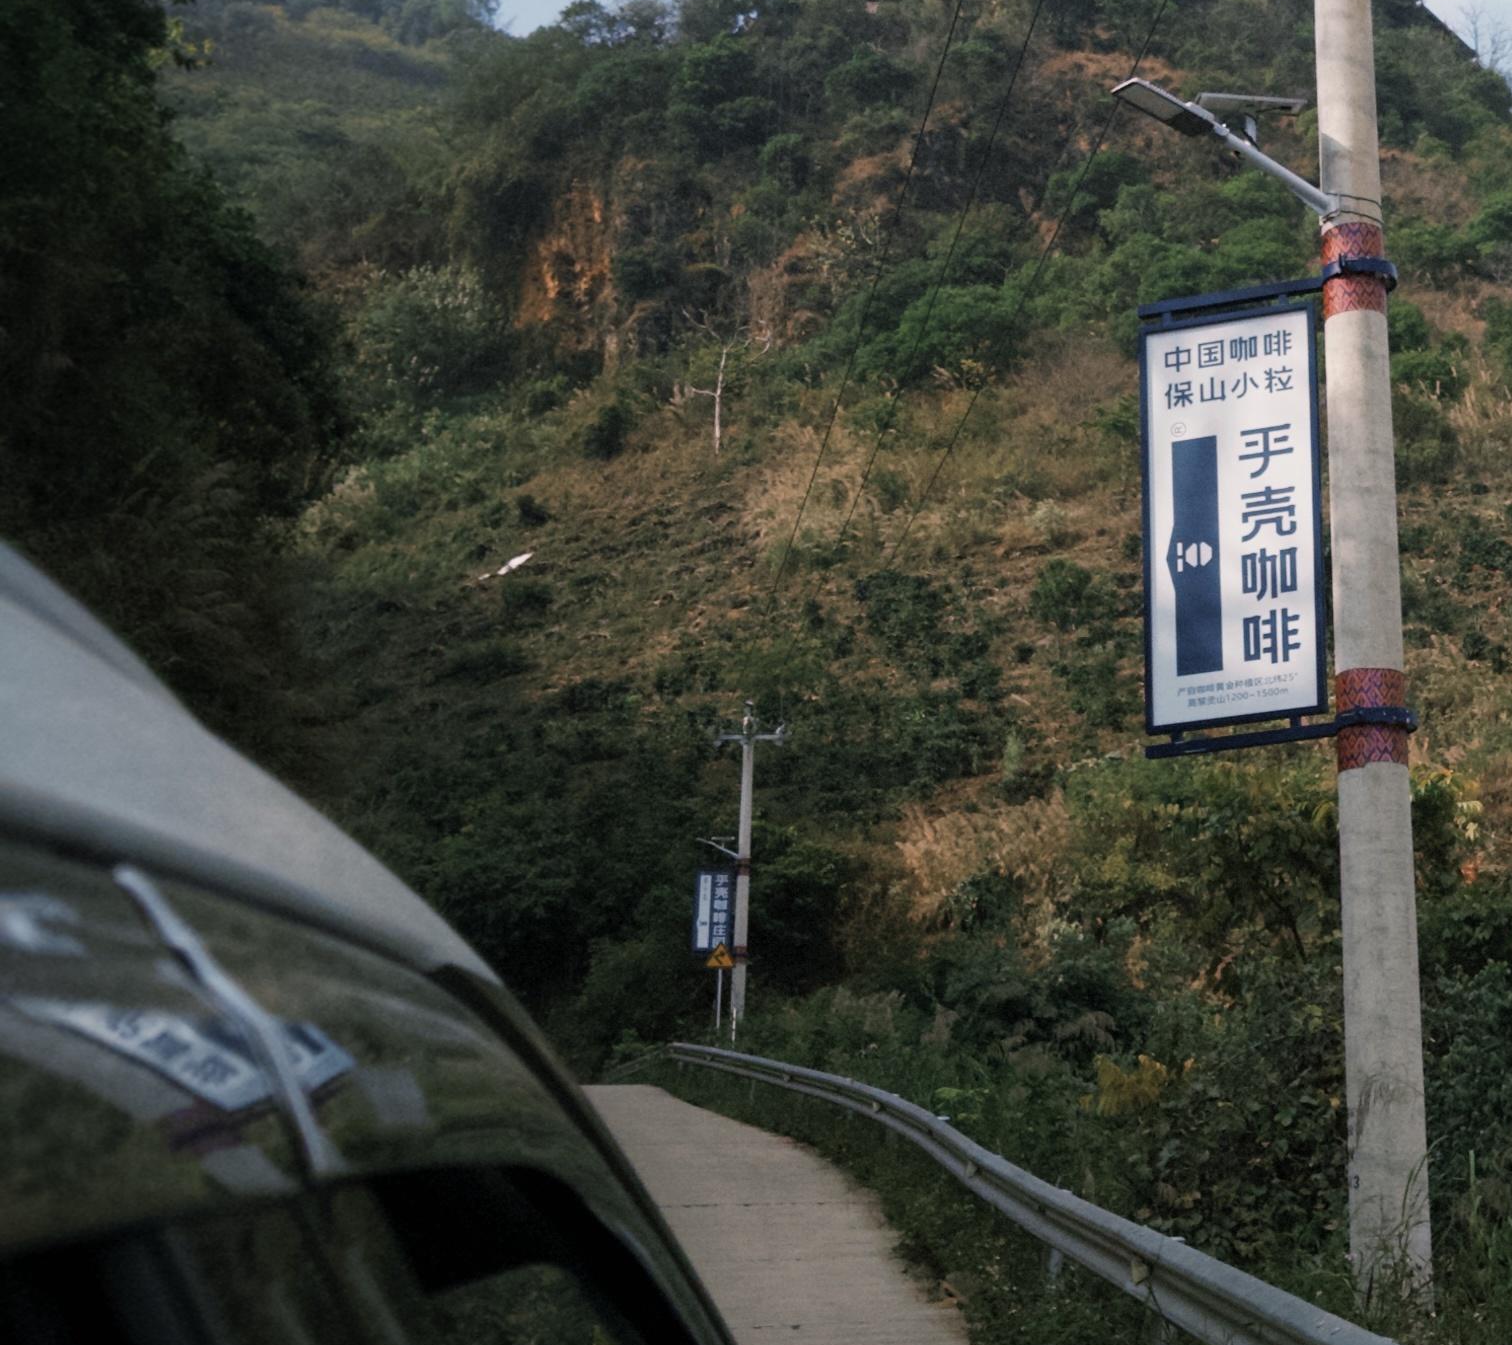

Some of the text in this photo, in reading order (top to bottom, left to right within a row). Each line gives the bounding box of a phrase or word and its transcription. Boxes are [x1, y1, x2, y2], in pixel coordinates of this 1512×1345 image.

[1165, 330, 1292, 372] 中国咖啡
[1165, 366, 1293, 410] 保山小粒
[1238, 423, 1301, 665] 乎壳咖啡
